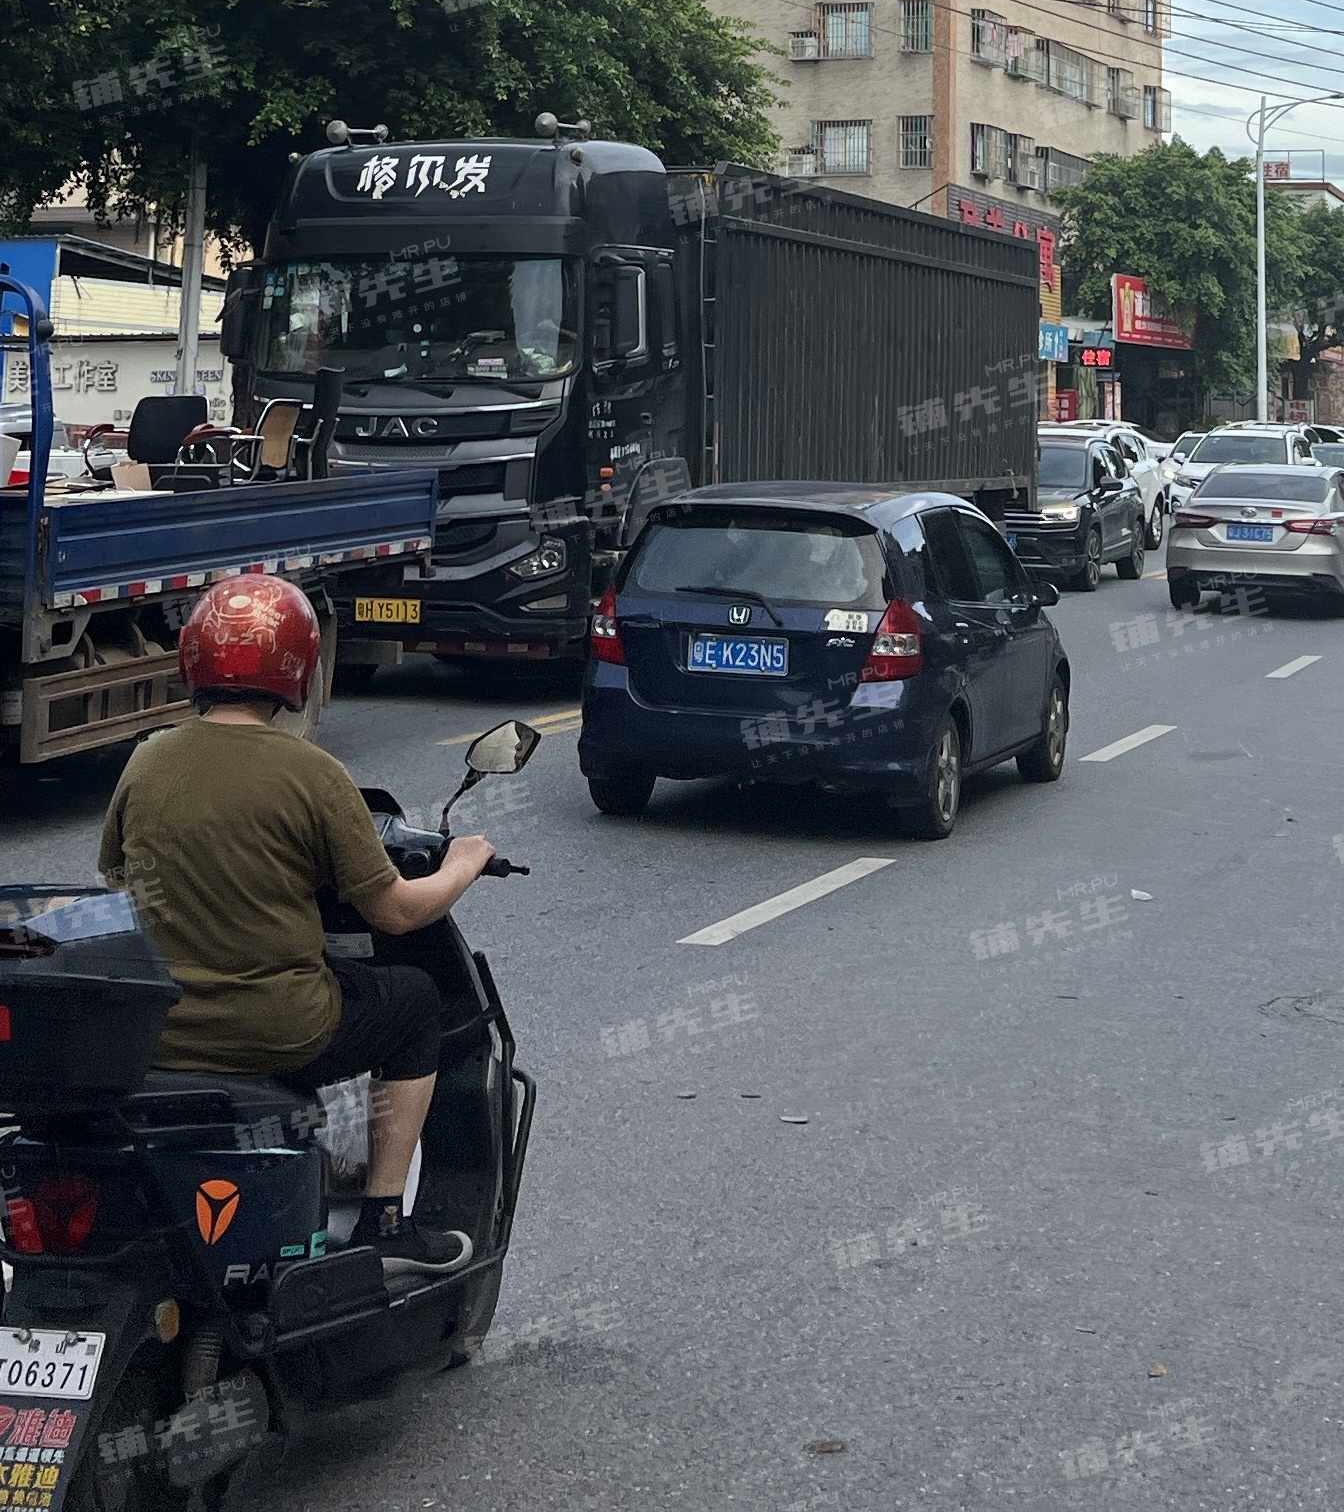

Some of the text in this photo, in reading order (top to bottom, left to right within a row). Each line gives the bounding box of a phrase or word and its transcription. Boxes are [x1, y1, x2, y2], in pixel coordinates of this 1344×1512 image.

[357, 153, 493, 200] 格尔发
[9, 360, 119, 394] 美工作室
[355, 416, 439, 439] JAC
